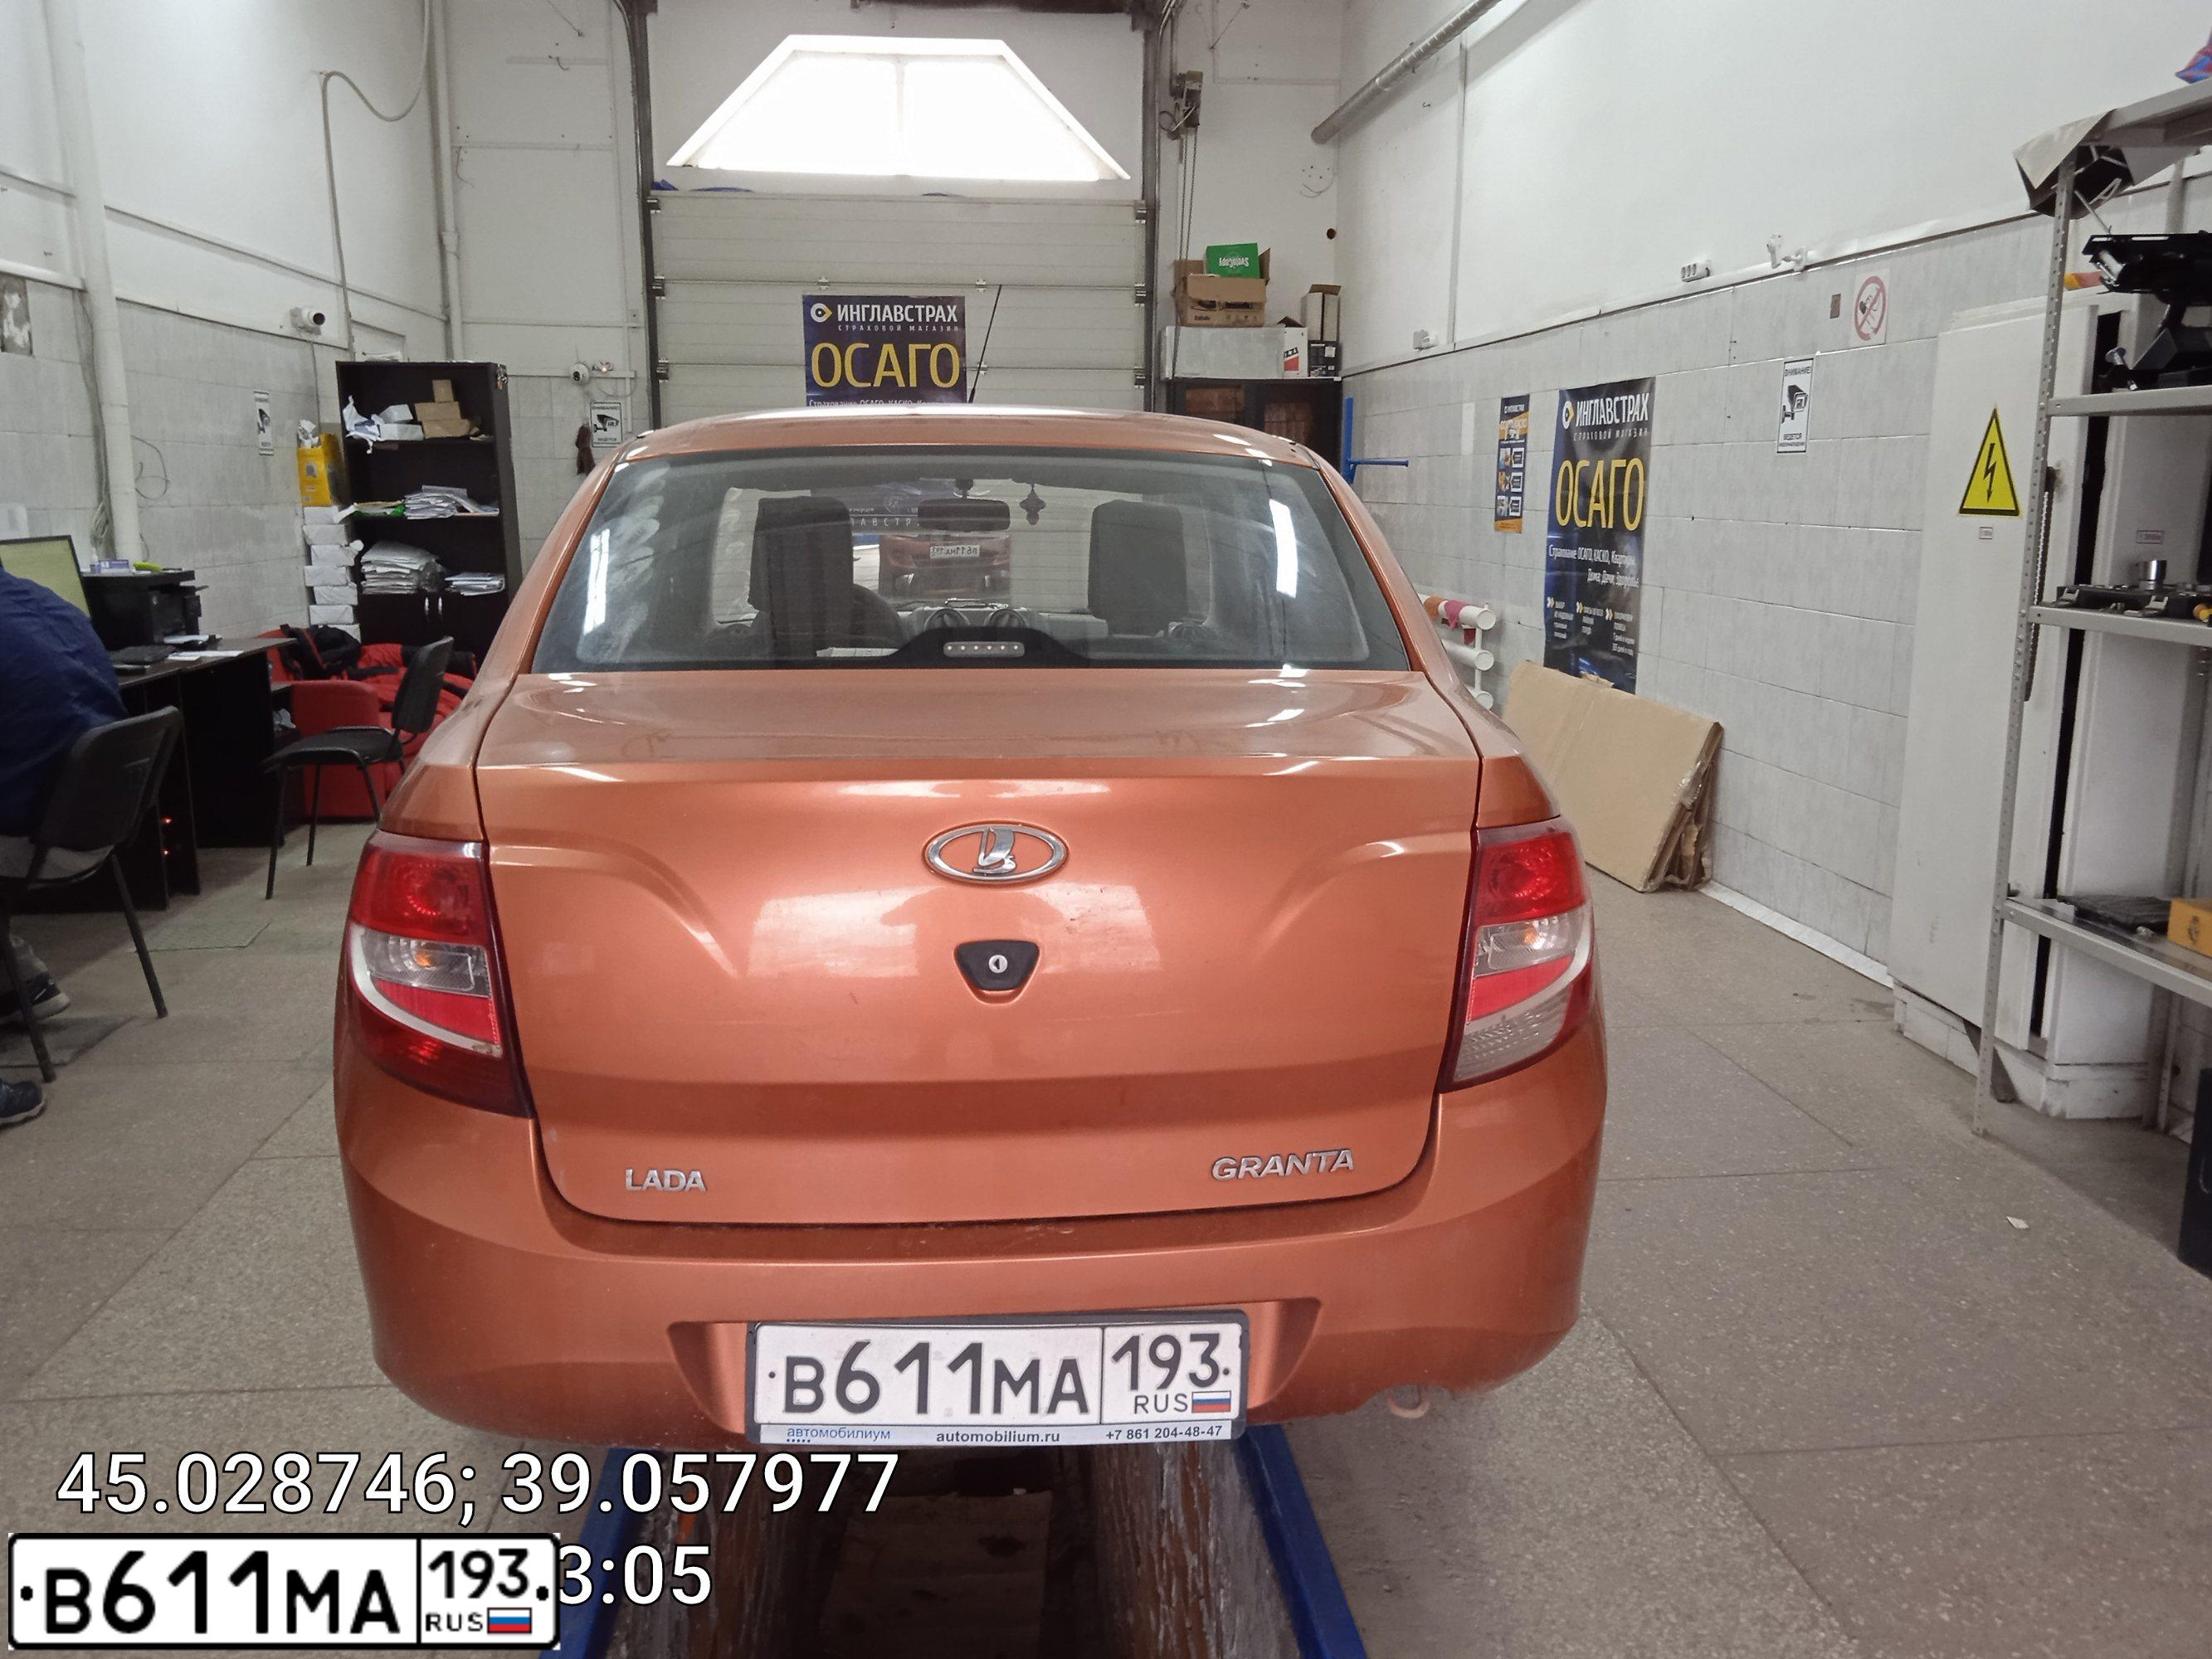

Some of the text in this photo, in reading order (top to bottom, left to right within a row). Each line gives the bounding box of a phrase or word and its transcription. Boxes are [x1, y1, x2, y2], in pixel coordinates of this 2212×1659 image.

[837, 304, 957, 323] ИНГЛАВСТРАХ
[811, 342, 960, 388] ОСАГО
[1576, 393, 1650, 427] ИНГЛАВСТРАХ
[1573, 428, 1649, 442] СТРАХОВОЙ МАГАЗИН
[1556, 458, 1644, 531] ОСАГО
[1211, 1148, 1355, 1181] GRANTA
[625, 1167, 706, 1193] LADA
[782, 1332, 1223, 1416] В611МА 193
[1133, 1394, 1188, 1414] RUS
[787, 1427, 890, 1442] автомобилиум
[937, 1429, 1060, 1443] automobilium.ru
[1106, 1425, 1222, 1440] +7 861 204-48-47
